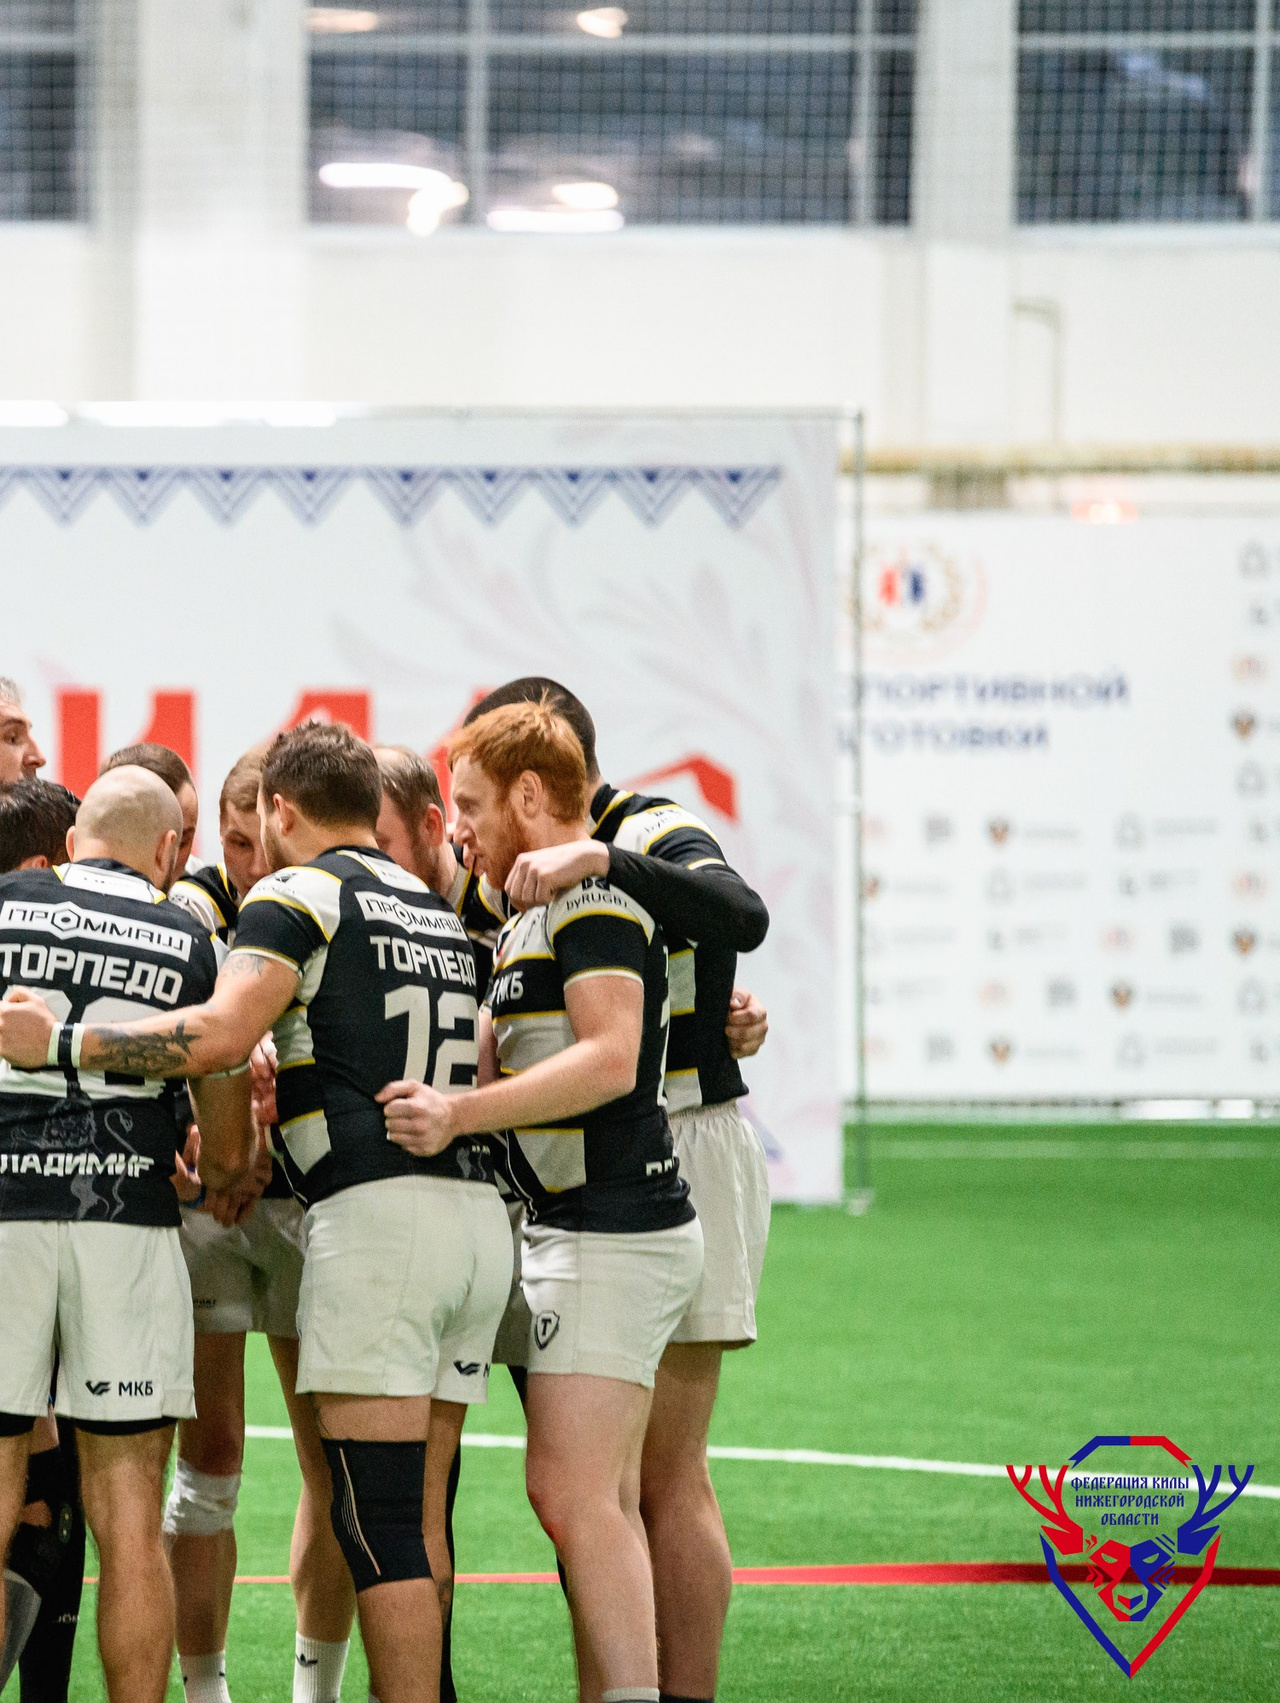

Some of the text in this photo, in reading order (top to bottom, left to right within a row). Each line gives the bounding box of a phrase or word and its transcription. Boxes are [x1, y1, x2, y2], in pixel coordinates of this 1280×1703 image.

[370, 934, 477, 988] ТОРПЕДО
[384, 984, 480, 1096] 12
[118, 1380, 154, 1397] МКБ
